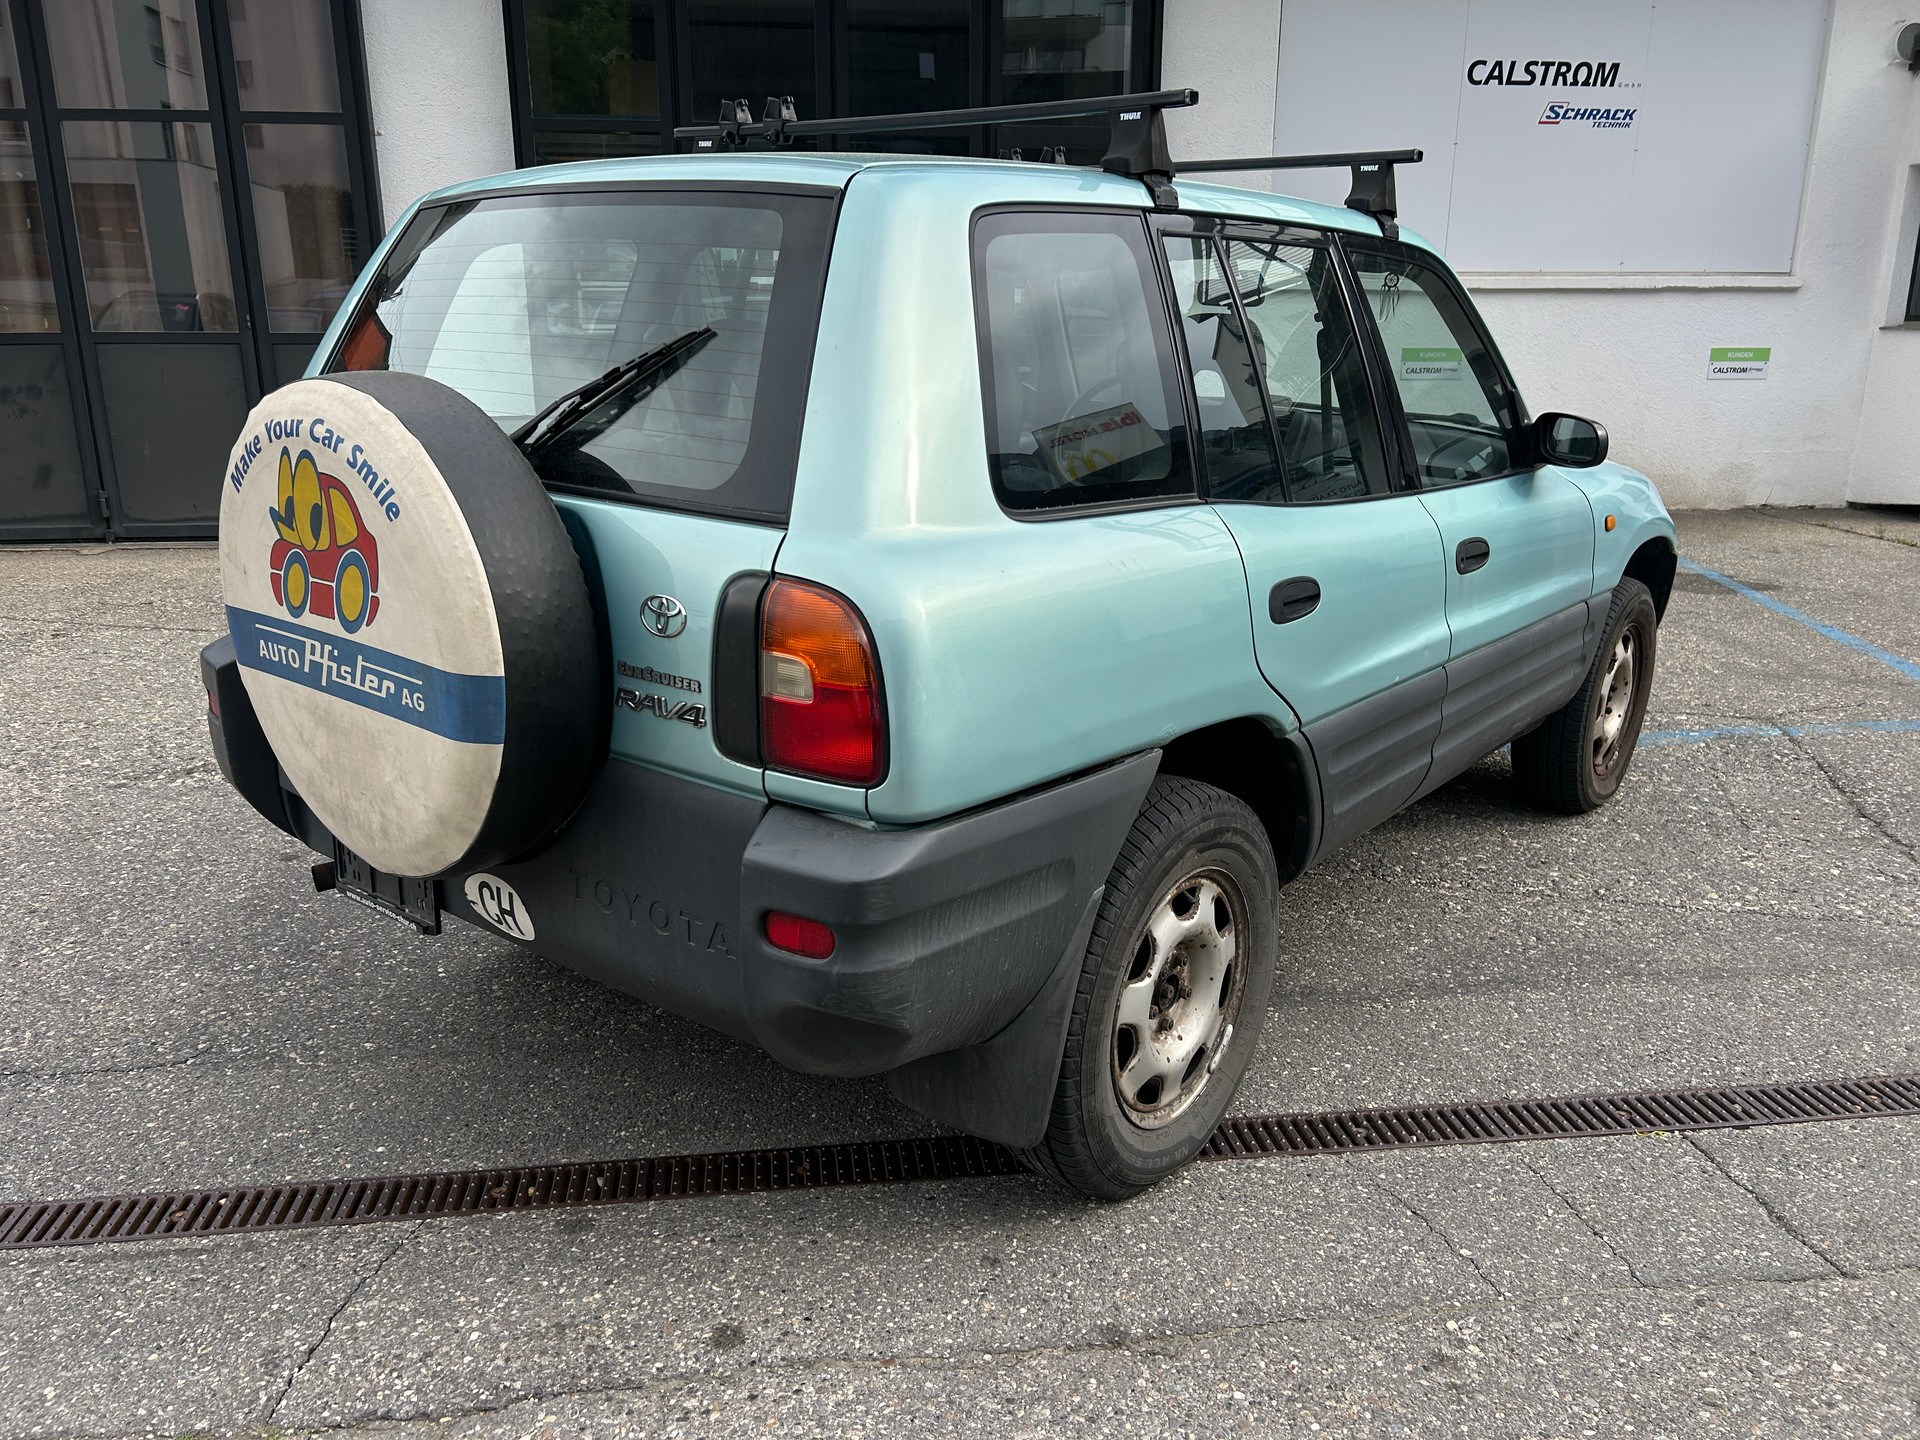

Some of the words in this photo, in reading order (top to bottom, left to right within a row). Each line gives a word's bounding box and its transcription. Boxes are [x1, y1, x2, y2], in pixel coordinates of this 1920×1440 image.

[1120, 111, 1142, 121] THULE
[1545, 104, 1638, 121] SCHRACK
[1592, 121, 1633, 129] TECHNIK
[1360, 164, 1380, 172] THULE
[229, 434, 262, 494] Make
[264, 418, 304, 446] Your
[309, 418, 345, 454] Car
[346, 444, 401, 523] Smile
[259, 638, 300, 669] AUTO
[301, 634, 420, 699] Pfister
[401, 688, 426, 713] AG
[615, 687, 707, 729] RAV4
[478, 879, 527, 937] CH
[569, 868, 737, 960] TOYOTA
